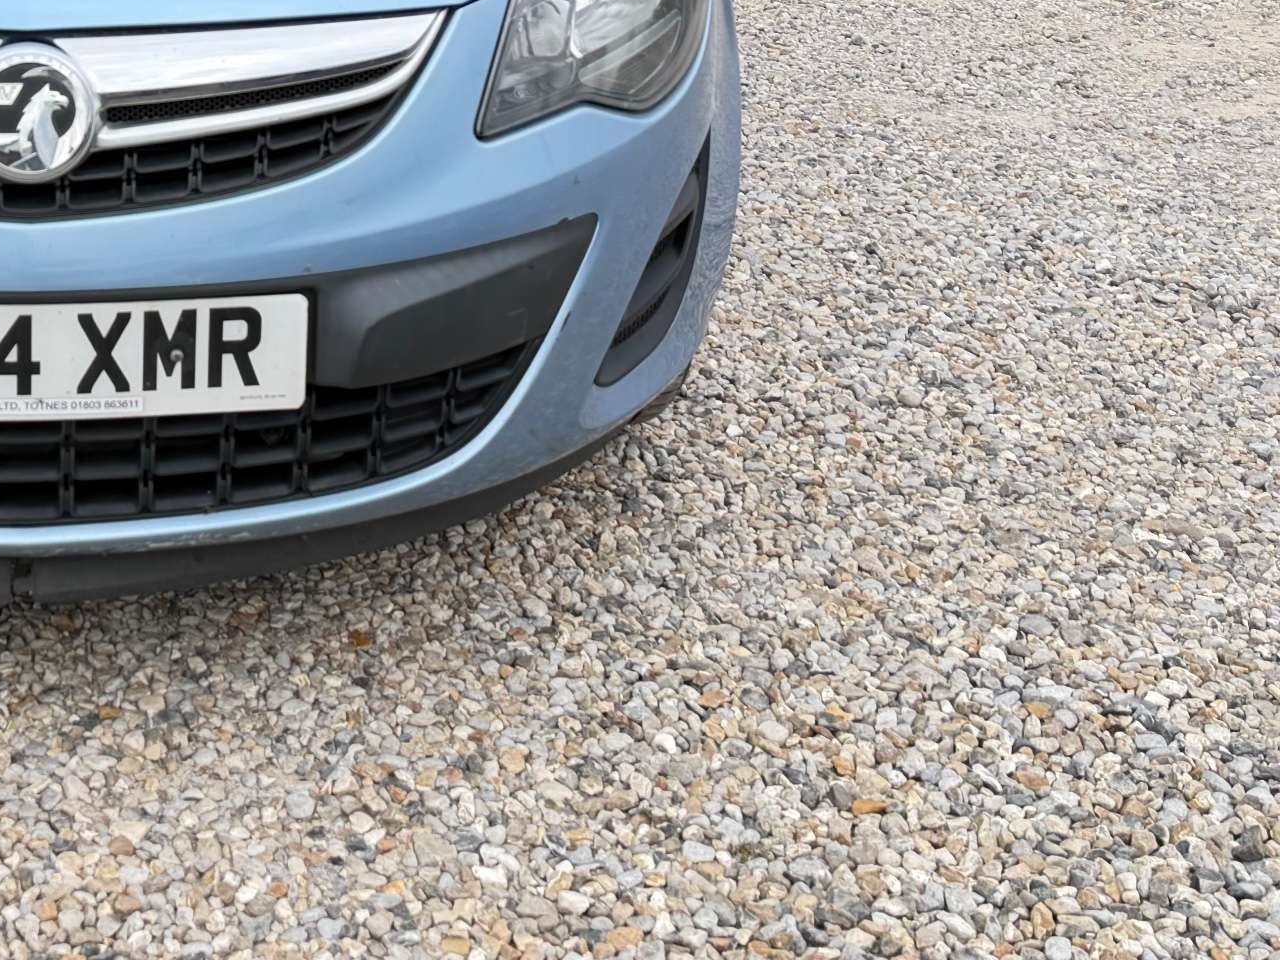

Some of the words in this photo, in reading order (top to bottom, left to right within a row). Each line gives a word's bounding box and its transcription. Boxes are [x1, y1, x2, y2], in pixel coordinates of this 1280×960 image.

[76, 306, 262, 394] XMR
[24, 400, 68, 410] TOTNES
[70, 399, 102, 409] 01803
